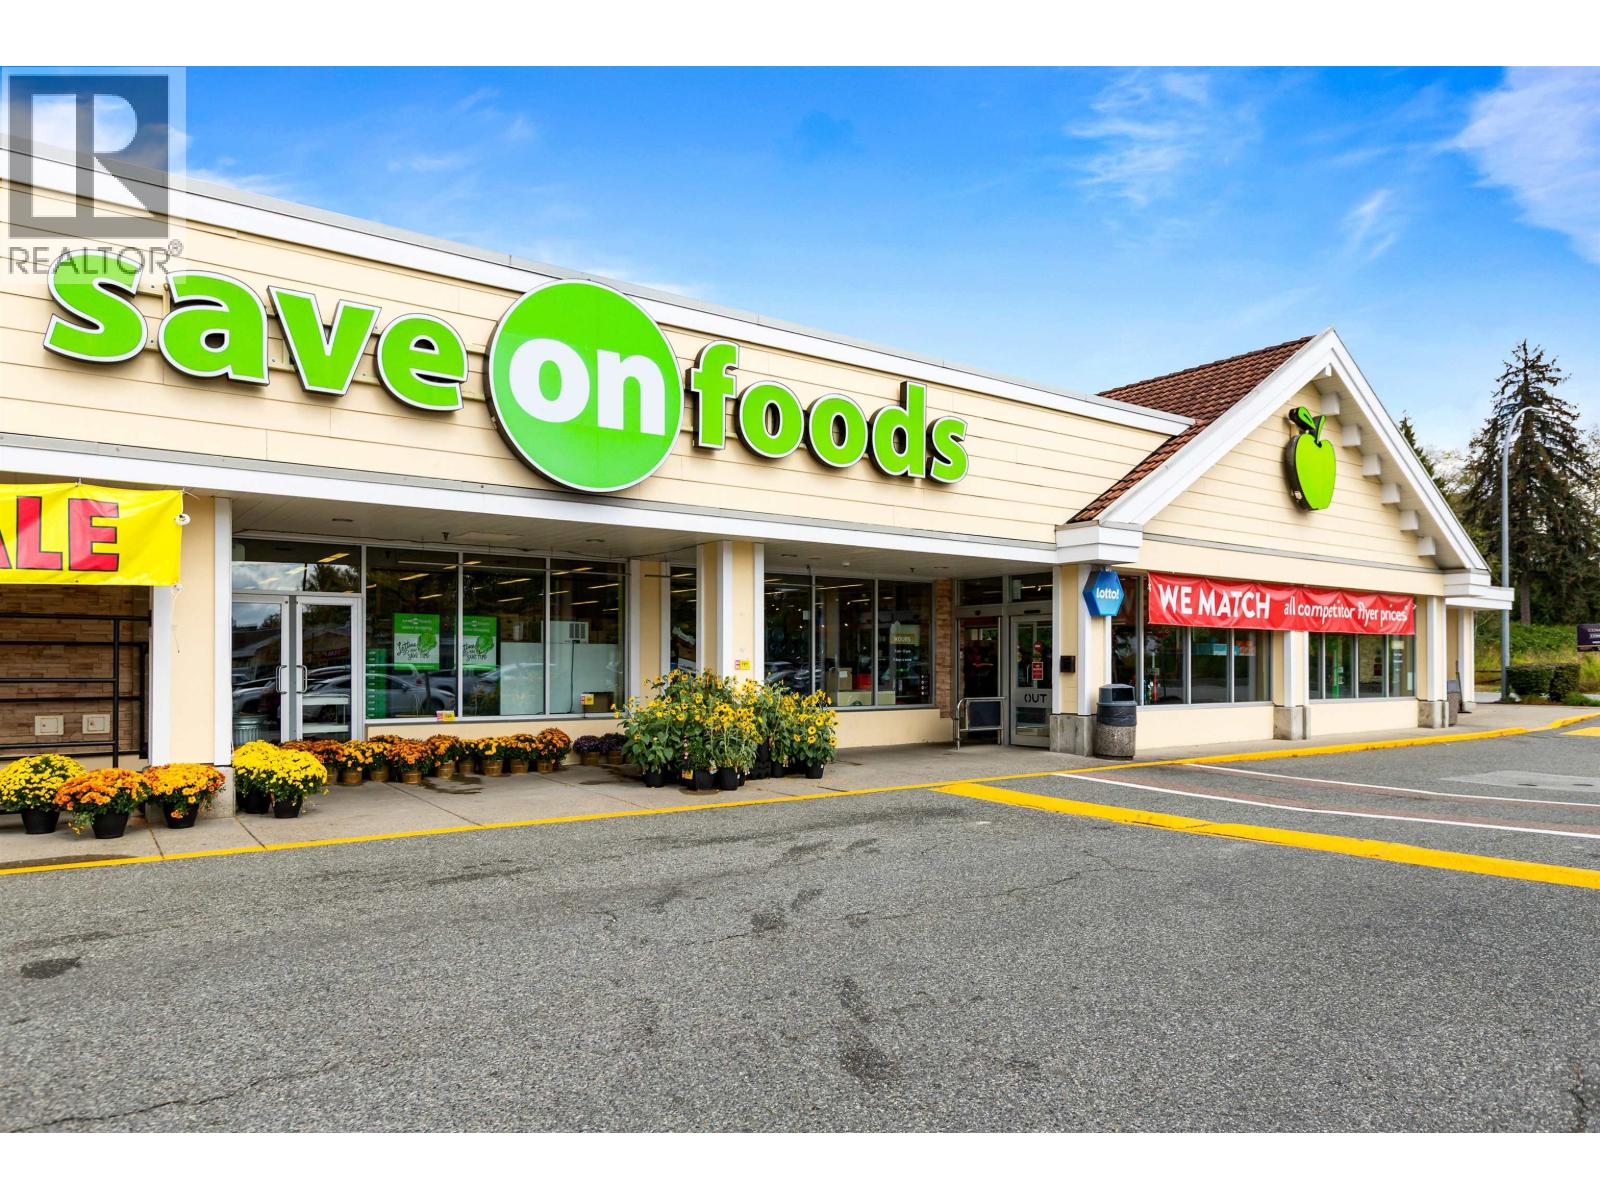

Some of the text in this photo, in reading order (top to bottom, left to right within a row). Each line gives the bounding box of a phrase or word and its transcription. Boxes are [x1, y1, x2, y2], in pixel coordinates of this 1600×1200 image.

[44, 249, 969, 484] save on foods
[0, 495, 119, 572] LE
[1158, 583, 1193, 615] WE
[1198, 586, 1271, 620] MATCH
[1284, 595, 1296, 616] all
[1297, 599, 1356, 625] competitor
[1358, 601, 1379, 627] flyer
[1024, 693, 1048, 704] OUT
